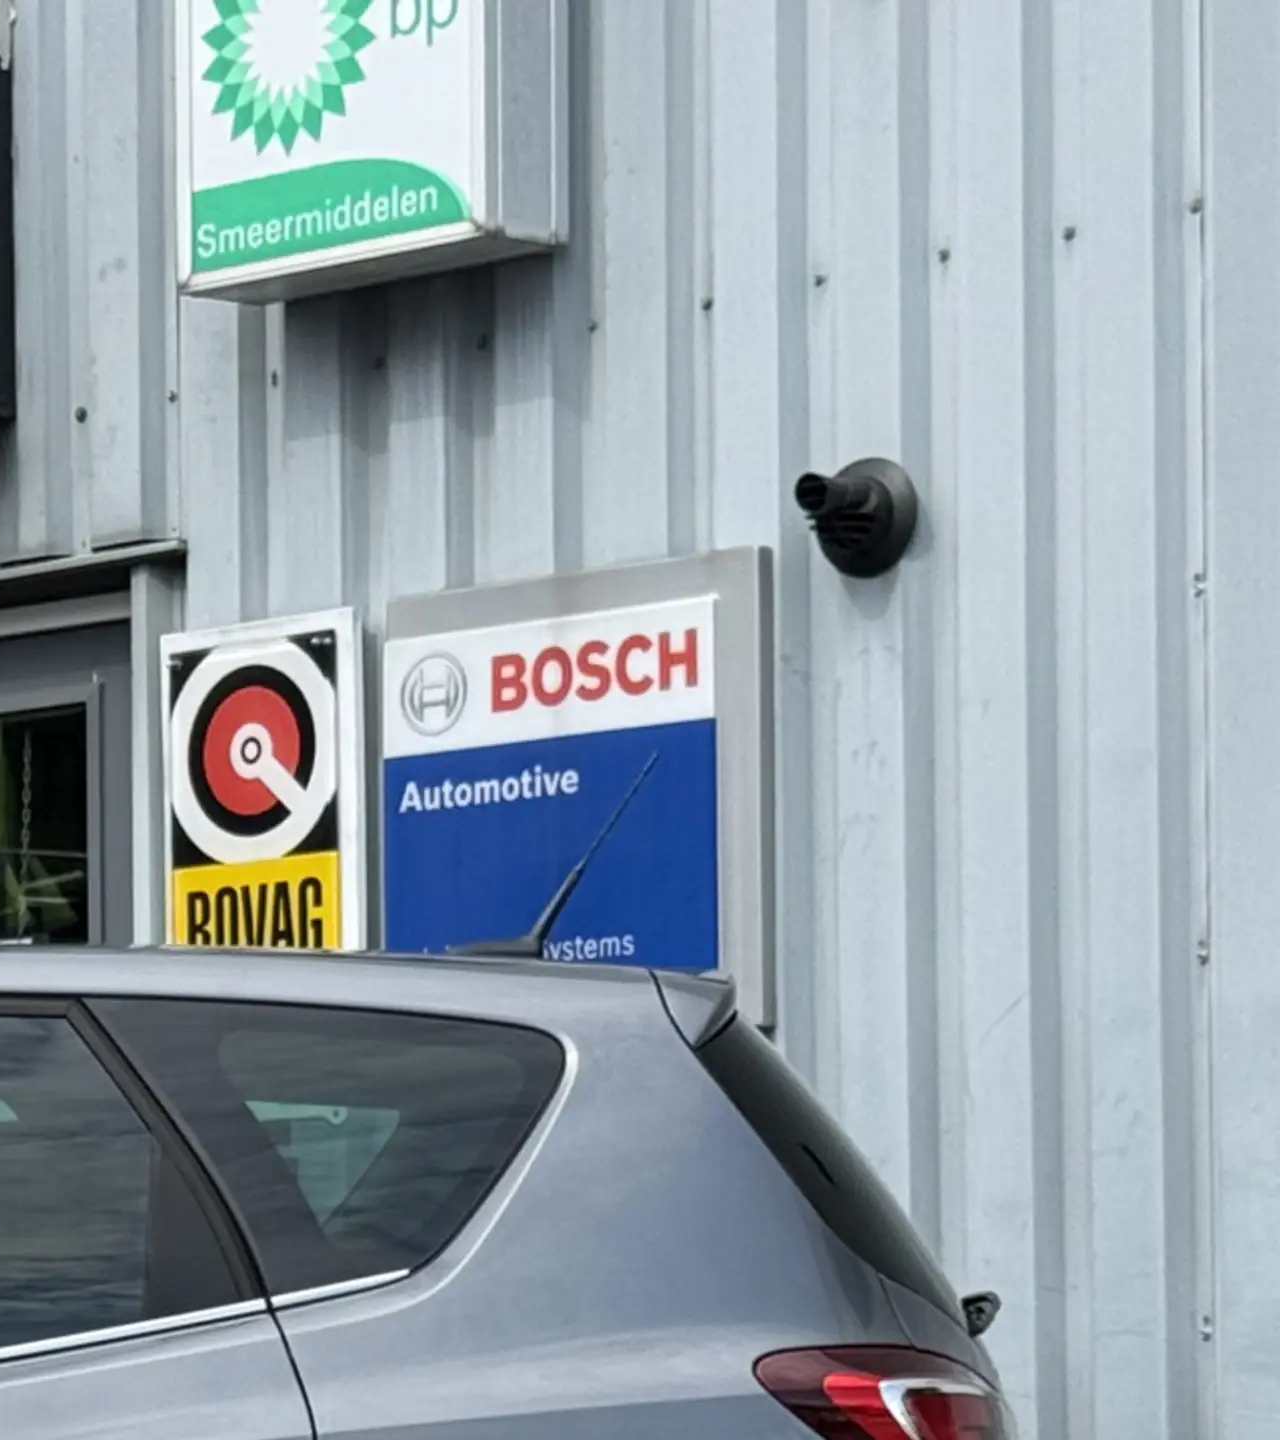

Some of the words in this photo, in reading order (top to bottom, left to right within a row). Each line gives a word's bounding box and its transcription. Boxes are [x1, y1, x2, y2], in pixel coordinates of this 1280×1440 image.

[196, 184, 439, 258] Smeermiddelen
[491, 627, 698, 713] BOSCH
[398, 763, 580, 814] Automotive
[542, 934, 636, 961] ystems
